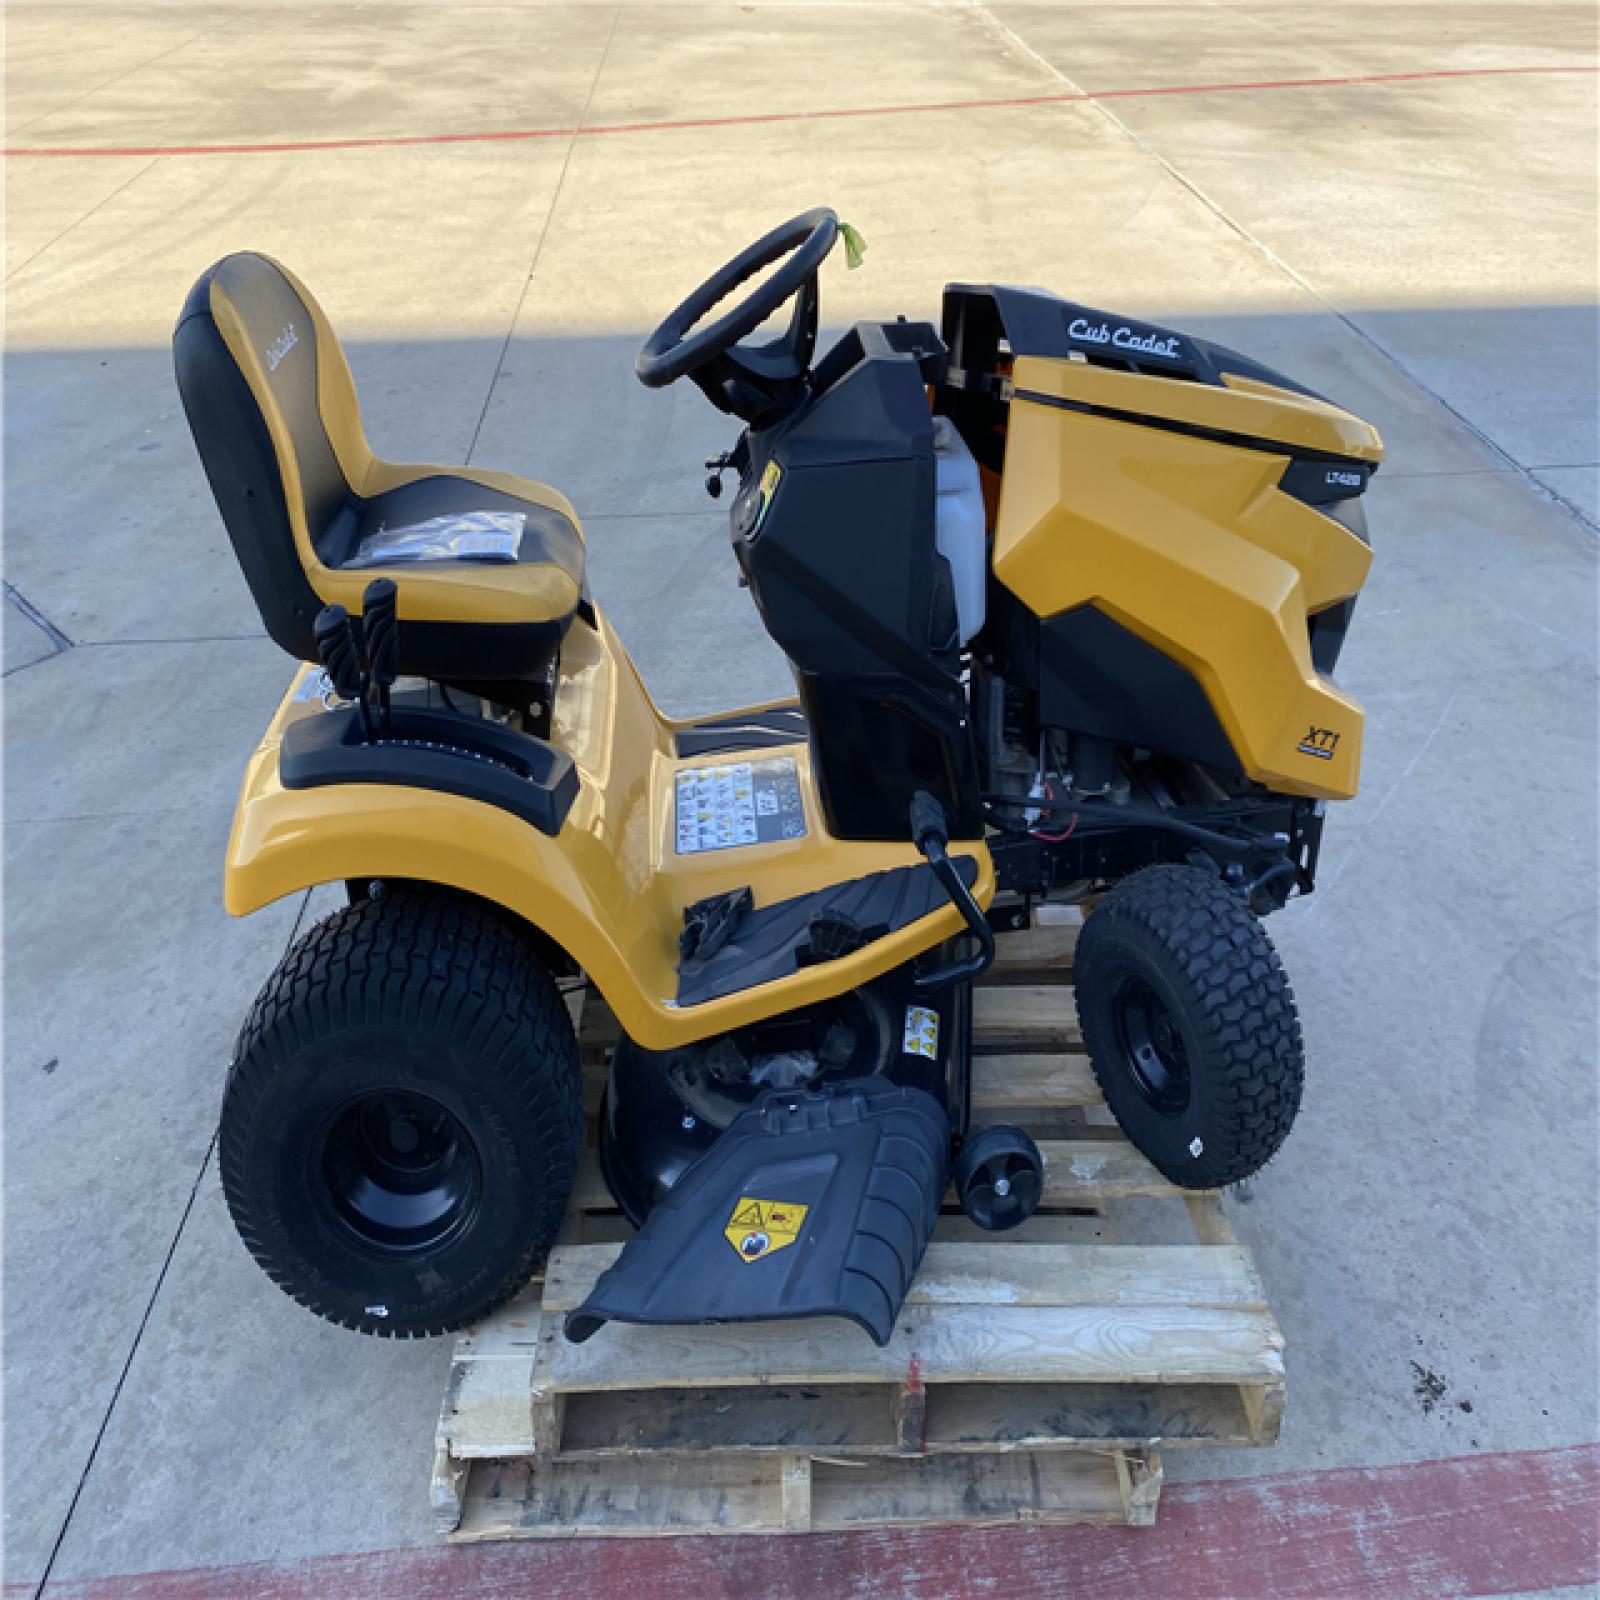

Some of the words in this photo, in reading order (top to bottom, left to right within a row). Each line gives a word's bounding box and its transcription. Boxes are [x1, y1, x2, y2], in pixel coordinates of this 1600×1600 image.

[1067, 318, 1111, 344] Cub
[1112, 326, 1180, 359] Cadet
[1326, 471, 1361, 486] LT4
[1300, 725, 1340, 753] XT1
